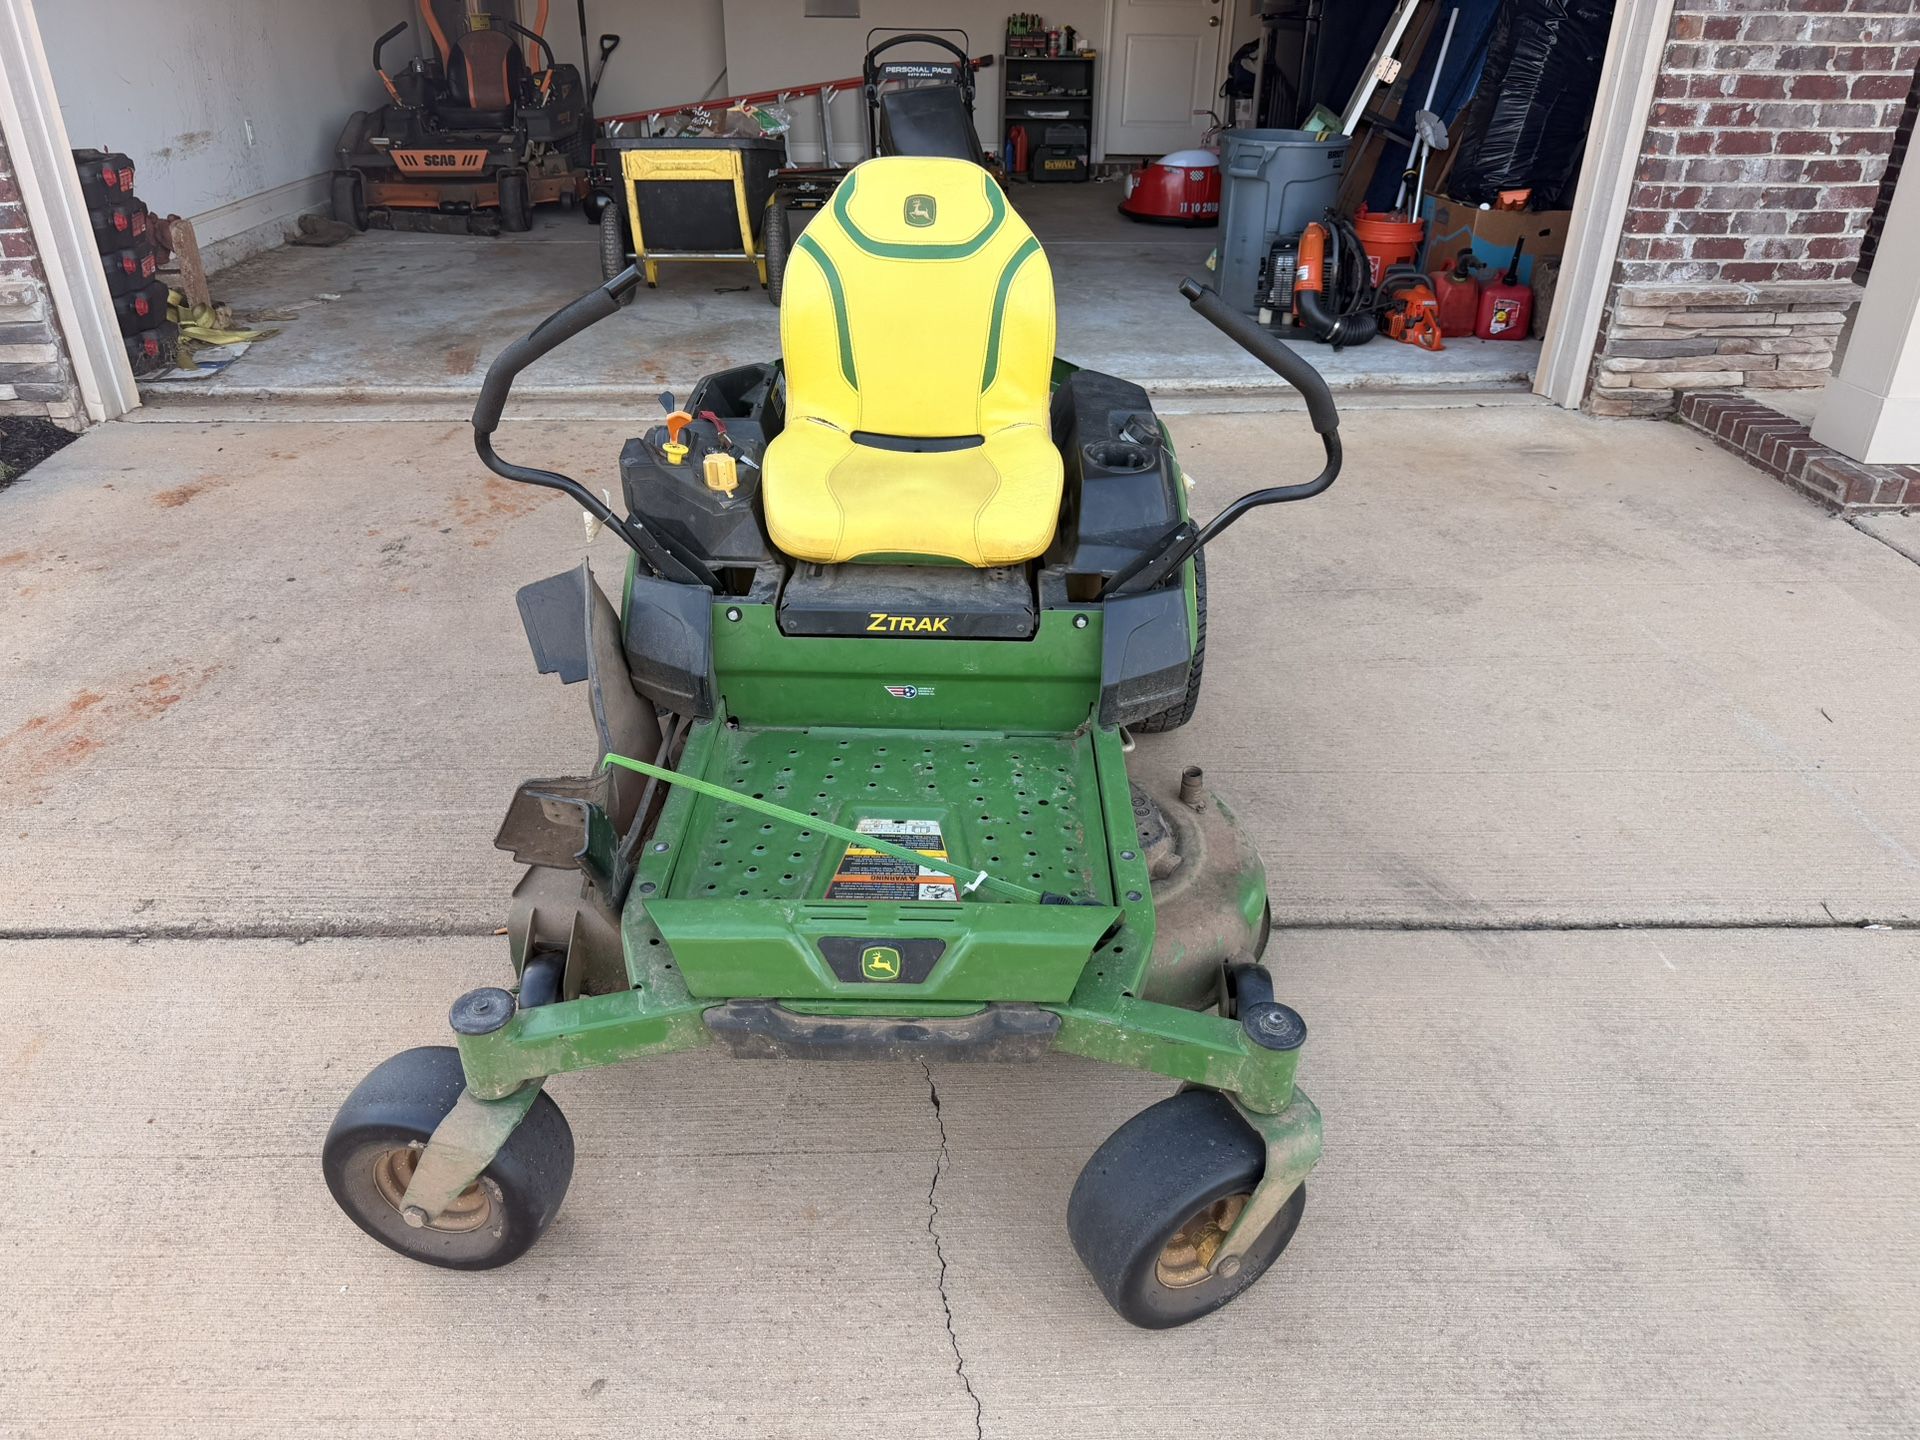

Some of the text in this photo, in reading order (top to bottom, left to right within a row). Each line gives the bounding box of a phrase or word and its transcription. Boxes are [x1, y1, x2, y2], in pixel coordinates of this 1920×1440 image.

[424, 154, 456, 167] SCAG
[1191, 202, 1200, 213] 10
[866, 613, 950, 632] ZTRAK
